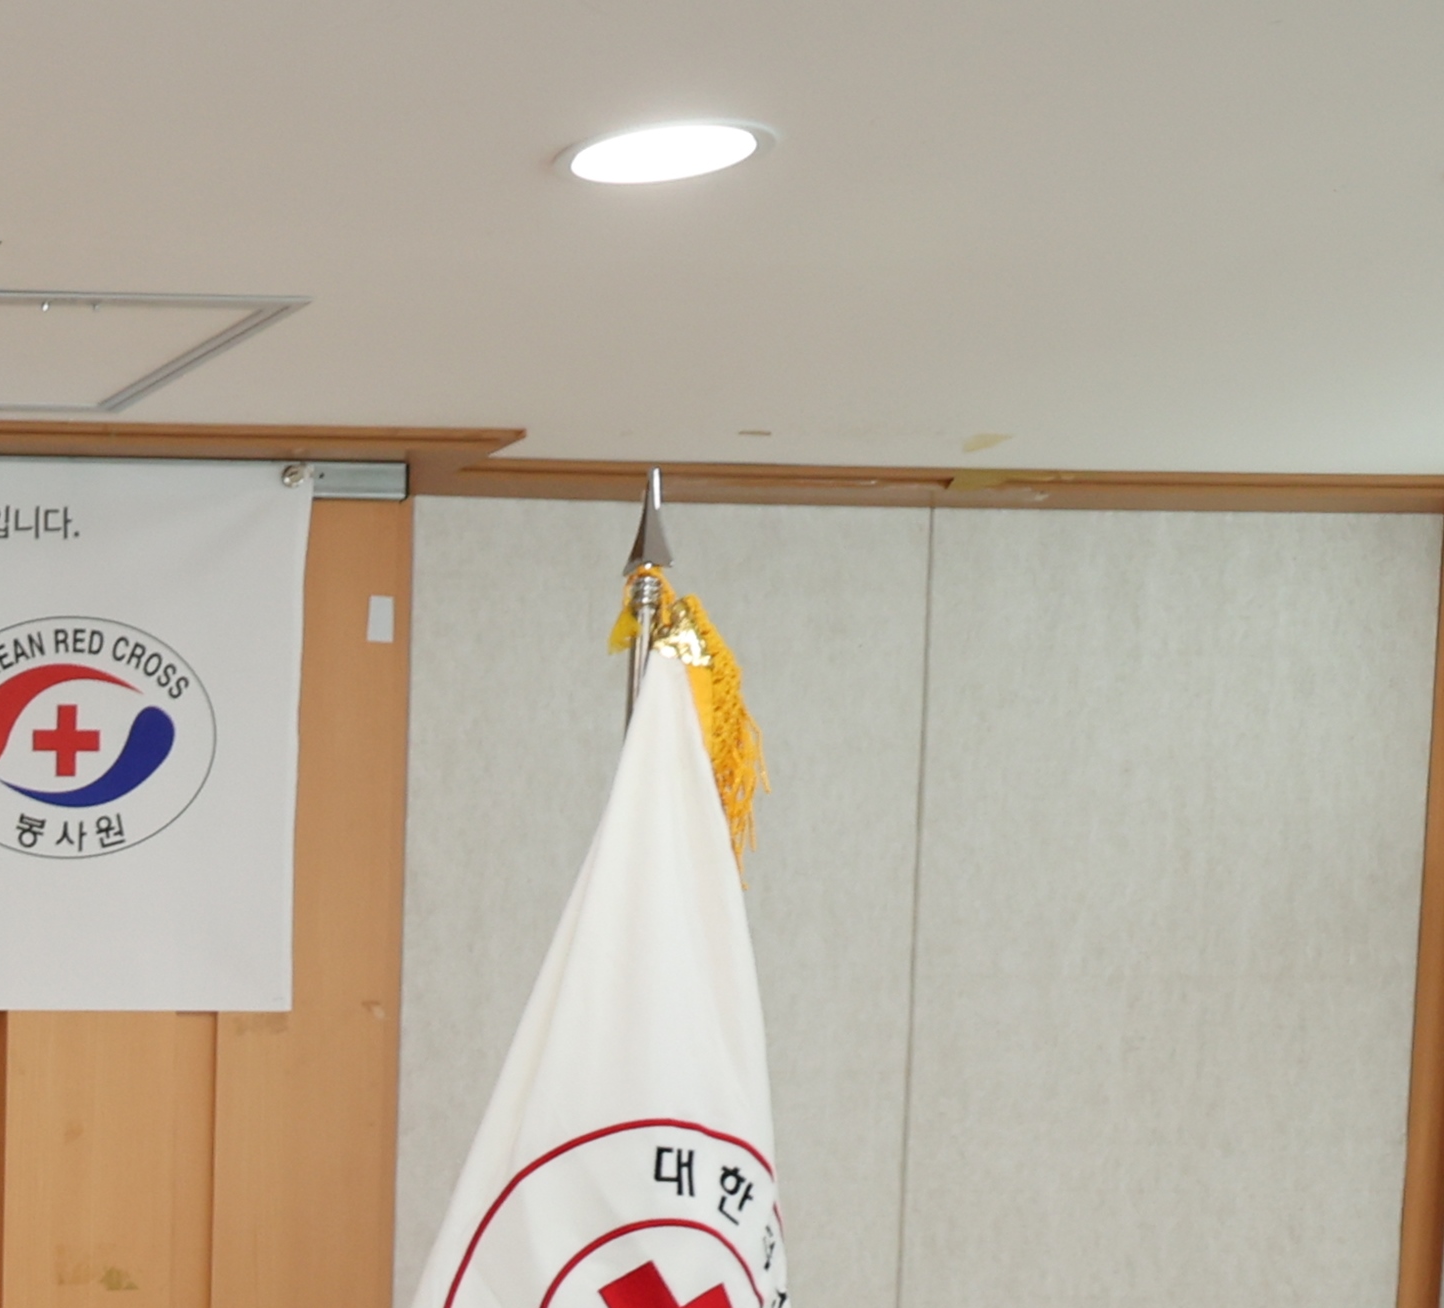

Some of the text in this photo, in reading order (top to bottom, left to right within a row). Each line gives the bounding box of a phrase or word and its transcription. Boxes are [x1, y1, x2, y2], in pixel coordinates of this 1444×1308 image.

[54, 628, 104, 656] RED
[111, 636, 190, 700] CROSS
[14, 812, 128, 853] 봉사원
